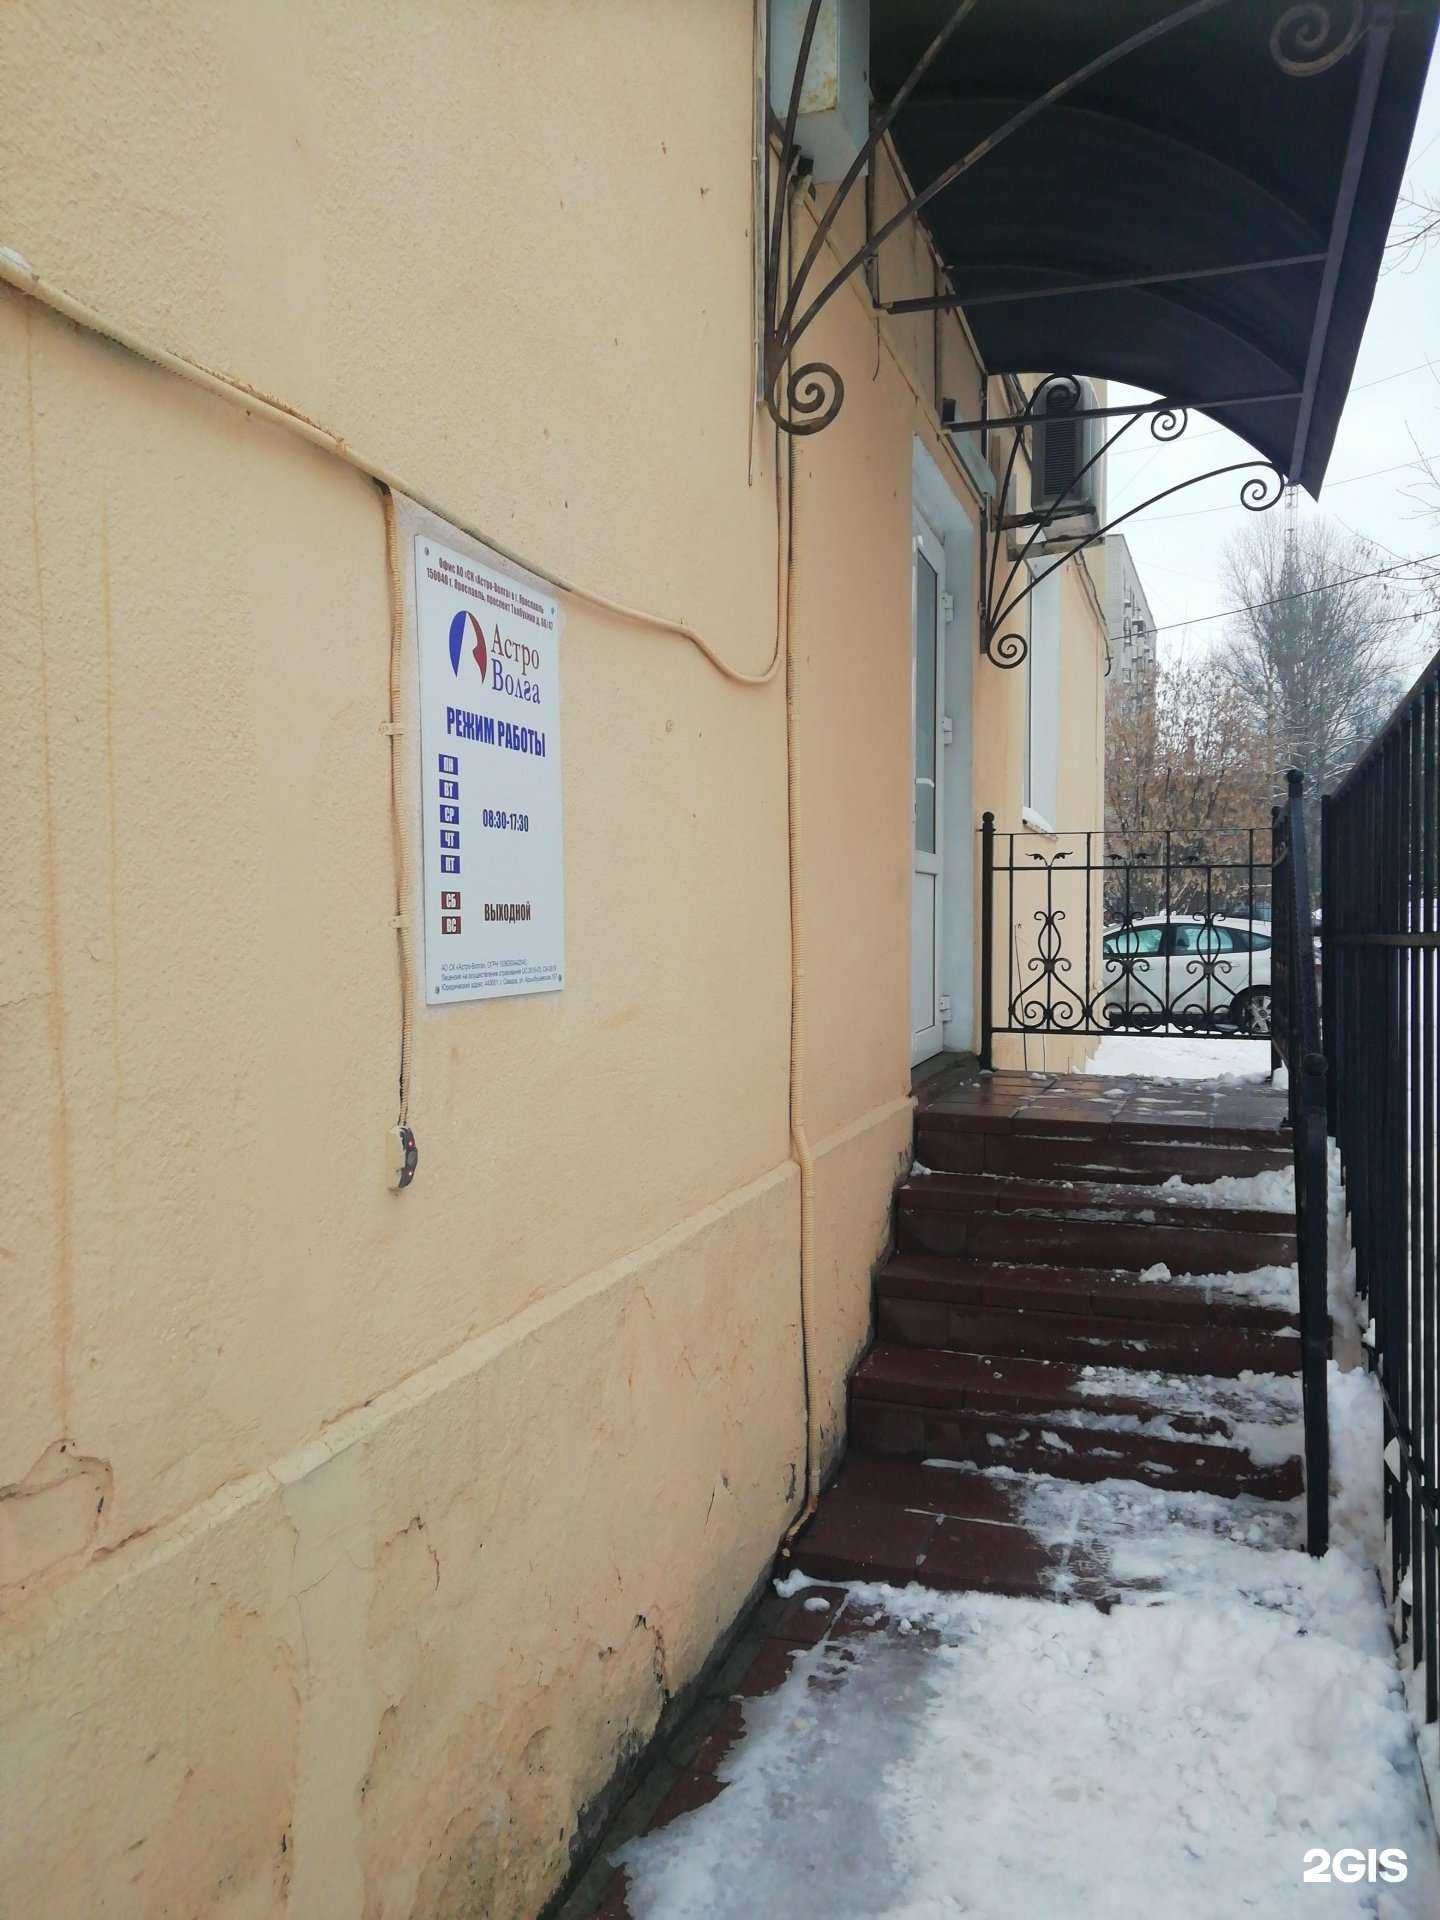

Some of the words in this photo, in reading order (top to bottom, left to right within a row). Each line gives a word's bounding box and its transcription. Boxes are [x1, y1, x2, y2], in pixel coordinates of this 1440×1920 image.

[456, 565, 464, 577] АО
[491, 623, 540, 676] Астро
[491, 658, 541, 704] Волга
[446, 706, 495, 745] РЕЖИМ
[498, 720, 546, 757] РАБОТЫ
[444, 781, 454, 797] ВТ
[444, 806, 455, 821] СР
[482, 808, 529, 832] 08:30-17:30
[445, 831, 455, 847] ЧТ
[445, 856, 455, 872] ПТ
[446, 893, 456, 908] СБ
[484, 901, 531, 924] ВЫХОДНОЙ
[446, 917, 457, 933] ВС
